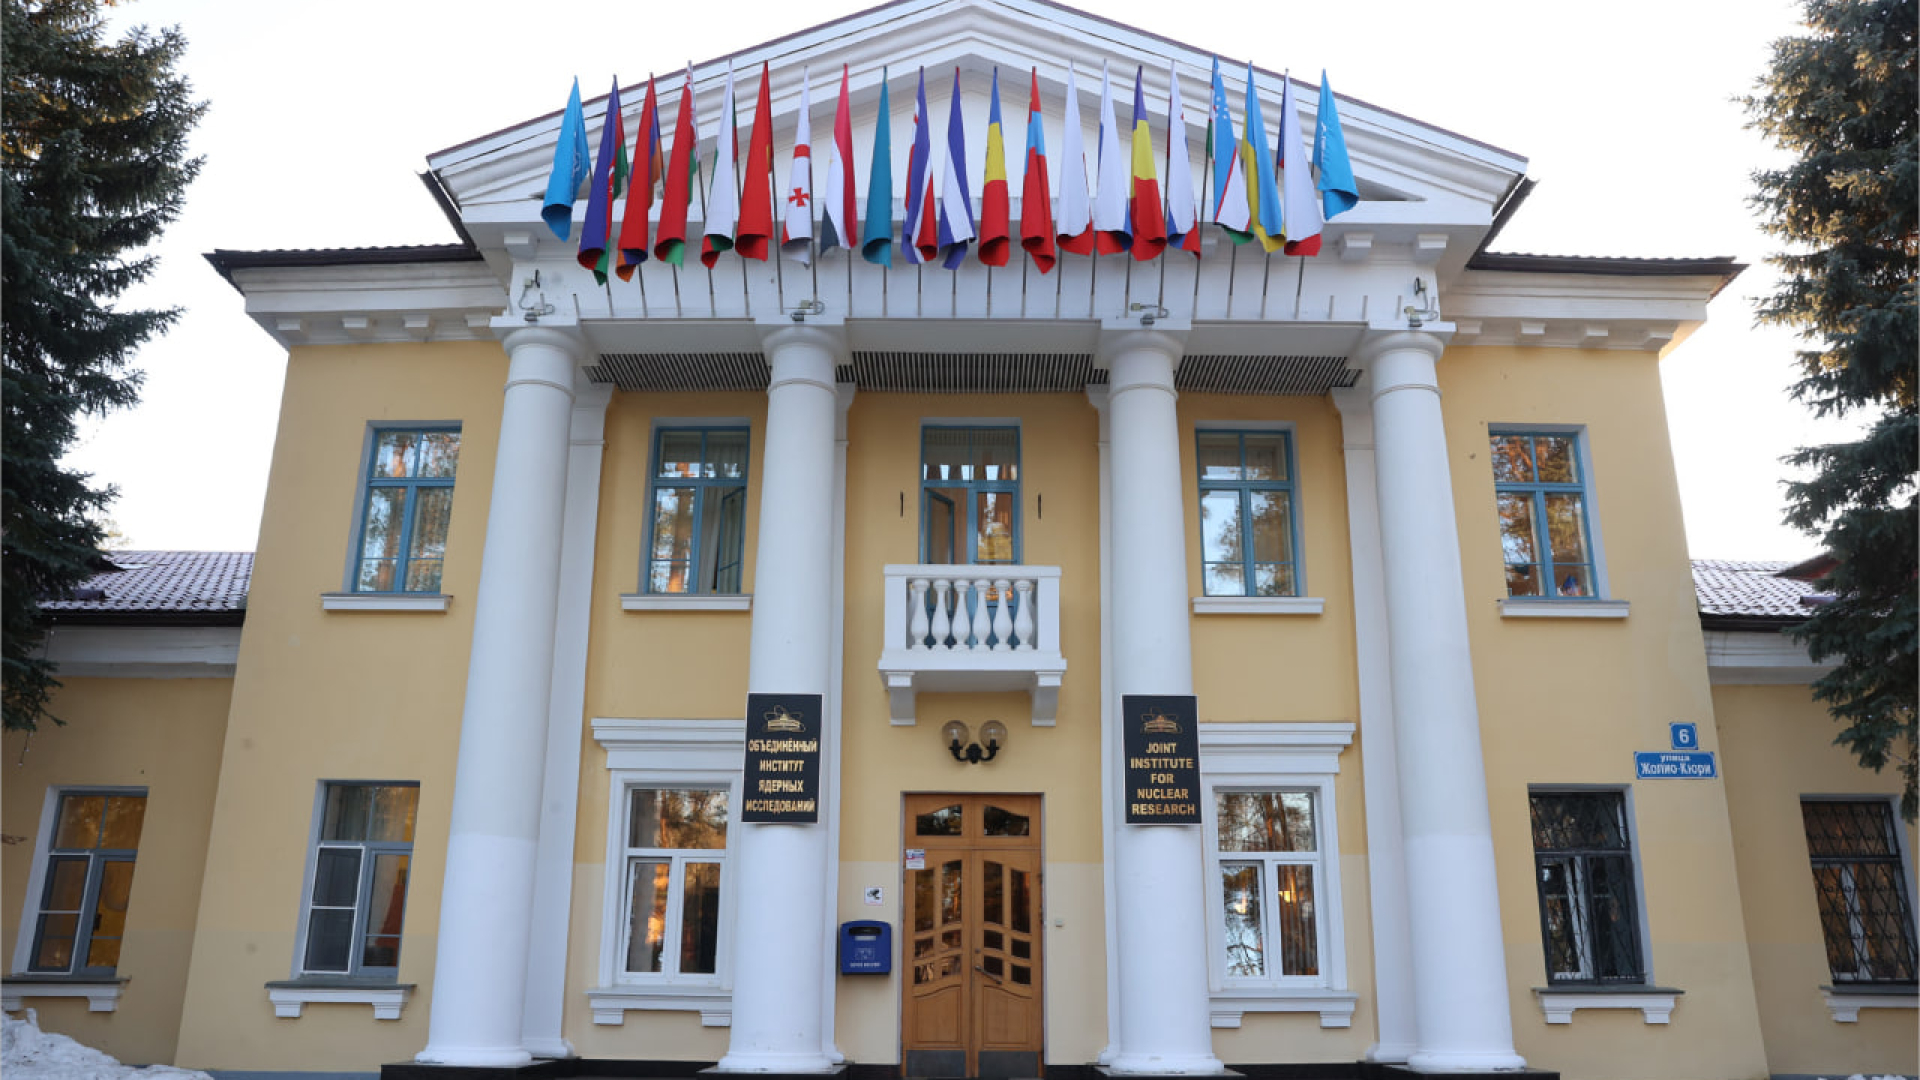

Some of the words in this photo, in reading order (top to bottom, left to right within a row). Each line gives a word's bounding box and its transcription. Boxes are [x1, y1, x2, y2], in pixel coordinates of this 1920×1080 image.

[1679, 728, 1690, 744] 6
[748, 738, 818, 753] ОБЪЕДИНЁННЫЙ
[1145, 742, 1177, 754] JOINT
[759, 759, 805, 772] ИНСТИТУТ
[1130, 758, 1194, 769] INSTITUTE
[1660, 755, 1691, 763] улица
[1640, 763, 1712, 776] Жолио-Кюри
[1150, 773, 1175, 784] FOR
[758, 779, 804, 794] ЯДЕРНЫХ
[1136, 788, 1189, 799] NUCLEAR
[745, 798, 815, 814] ИССЛЕДОВАНИЙ
[1131, 803, 1196, 816] RESEARCH
